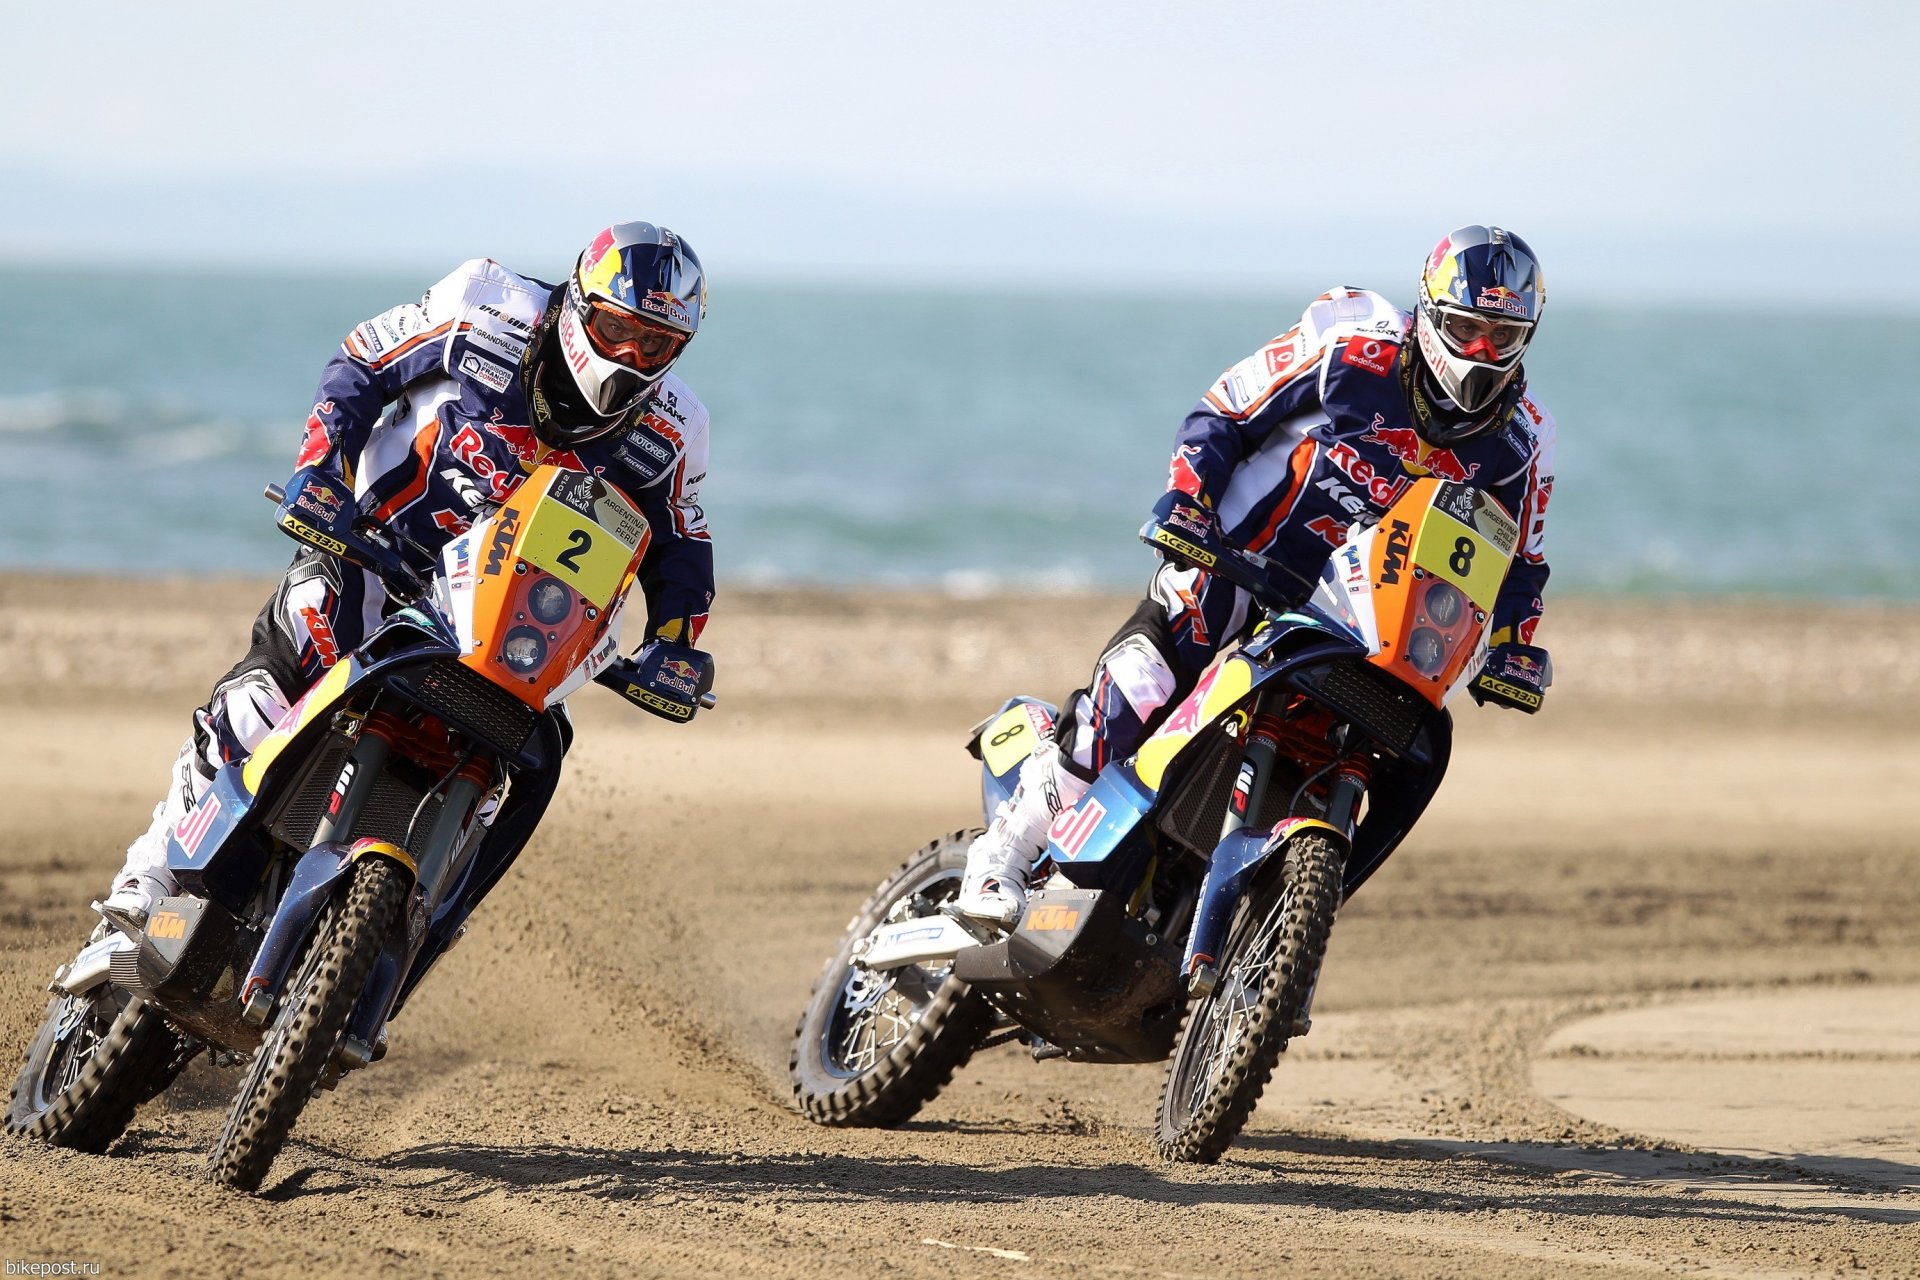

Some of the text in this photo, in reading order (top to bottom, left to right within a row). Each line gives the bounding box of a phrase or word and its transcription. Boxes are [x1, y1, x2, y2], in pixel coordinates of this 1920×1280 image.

[642, 299, 691, 325] Red Bull
[1476, 297, 1528, 316] Red Bull
[476, 328, 523, 356] GRANDVALIRA
[1355, 327, 1399, 338] SHARK
[480, 367, 509, 385] FRANCE
[483, 361, 511, 380] maisons
[1348, 353, 1385, 373] vodafone
[478, 372, 507, 389] CONFORT
[652, 396, 688, 426] SHARK
[629, 432, 667, 461] MOTOREX
[623, 456, 656, 478] MICHELIN
[553, 474, 571, 498] 2012
[1438, 485, 1453, 508] 2012
[296, 494, 337, 524] Red Bull
[565, 490, 591, 513] DAKAR
[604, 497, 645, 531] ARGENTINA
[1448, 500, 1471, 523] DAKAR
[619, 519, 641, 538] CHILE
[1169, 513, 1208, 539] Red Bull
[1482, 507, 1518, 538] ARGENTINA
[285, 519, 344, 553] ACERBIS
[483, 507, 521, 577] KTM
[615, 526, 636, 546] PERU
[1158, 533, 1214, 564] ACERBIS
[1493, 534, 1511, 552] PERU
[1496, 527, 1514, 545] CHILE
[556, 529, 592, 574] 2
[1380, 519, 1413, 585] KTM
[1448, 536, 1476, 578] 8
[299, 606, 340, 668] KTM
[656, 670, 696, 696] Red Bull
[1504, 664, 1541, 686] Red Bull
[629, 688, 688, 716] ACERBIS
[1481, 679, 1538, 705] ACERBIS
[990, 724, 1025, 747] 8
[147, 911, 187, 940] KTM
[1026, 904, 1080, 932] KTM
